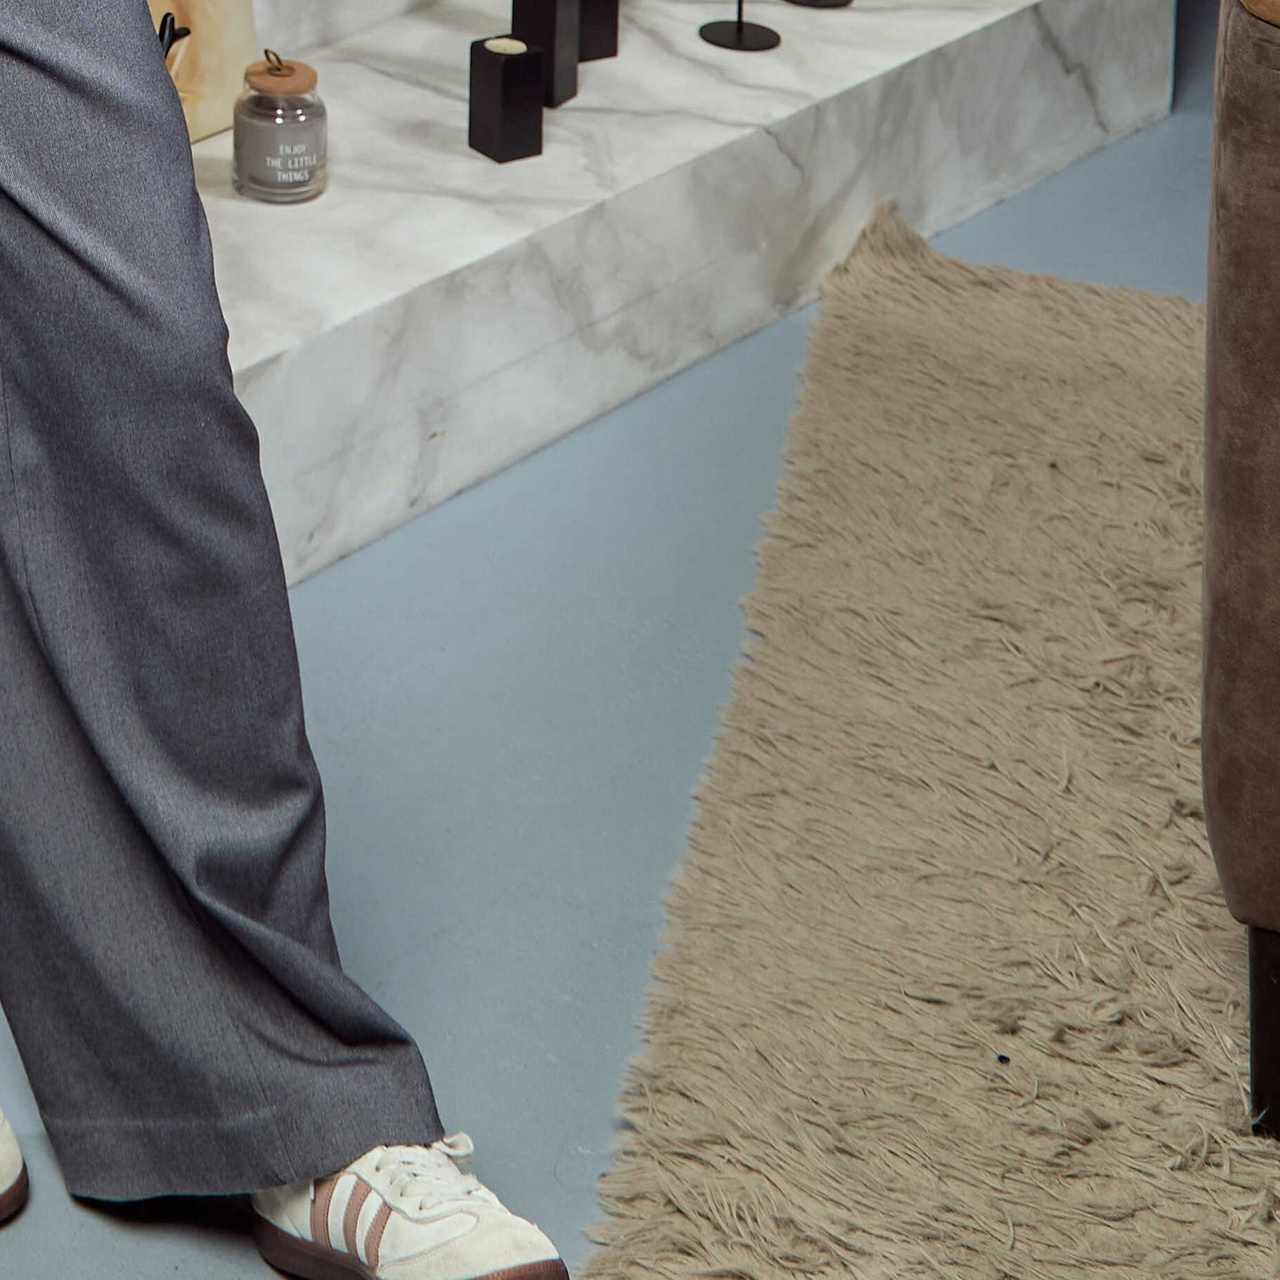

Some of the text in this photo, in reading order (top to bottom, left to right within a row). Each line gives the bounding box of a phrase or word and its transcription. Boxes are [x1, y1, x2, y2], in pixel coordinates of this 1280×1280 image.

[278, 143, 307, 155] ENJOY
[265, 153, 318, 169] THE LITTLE
[276, 169, 311, 183] THINGS
